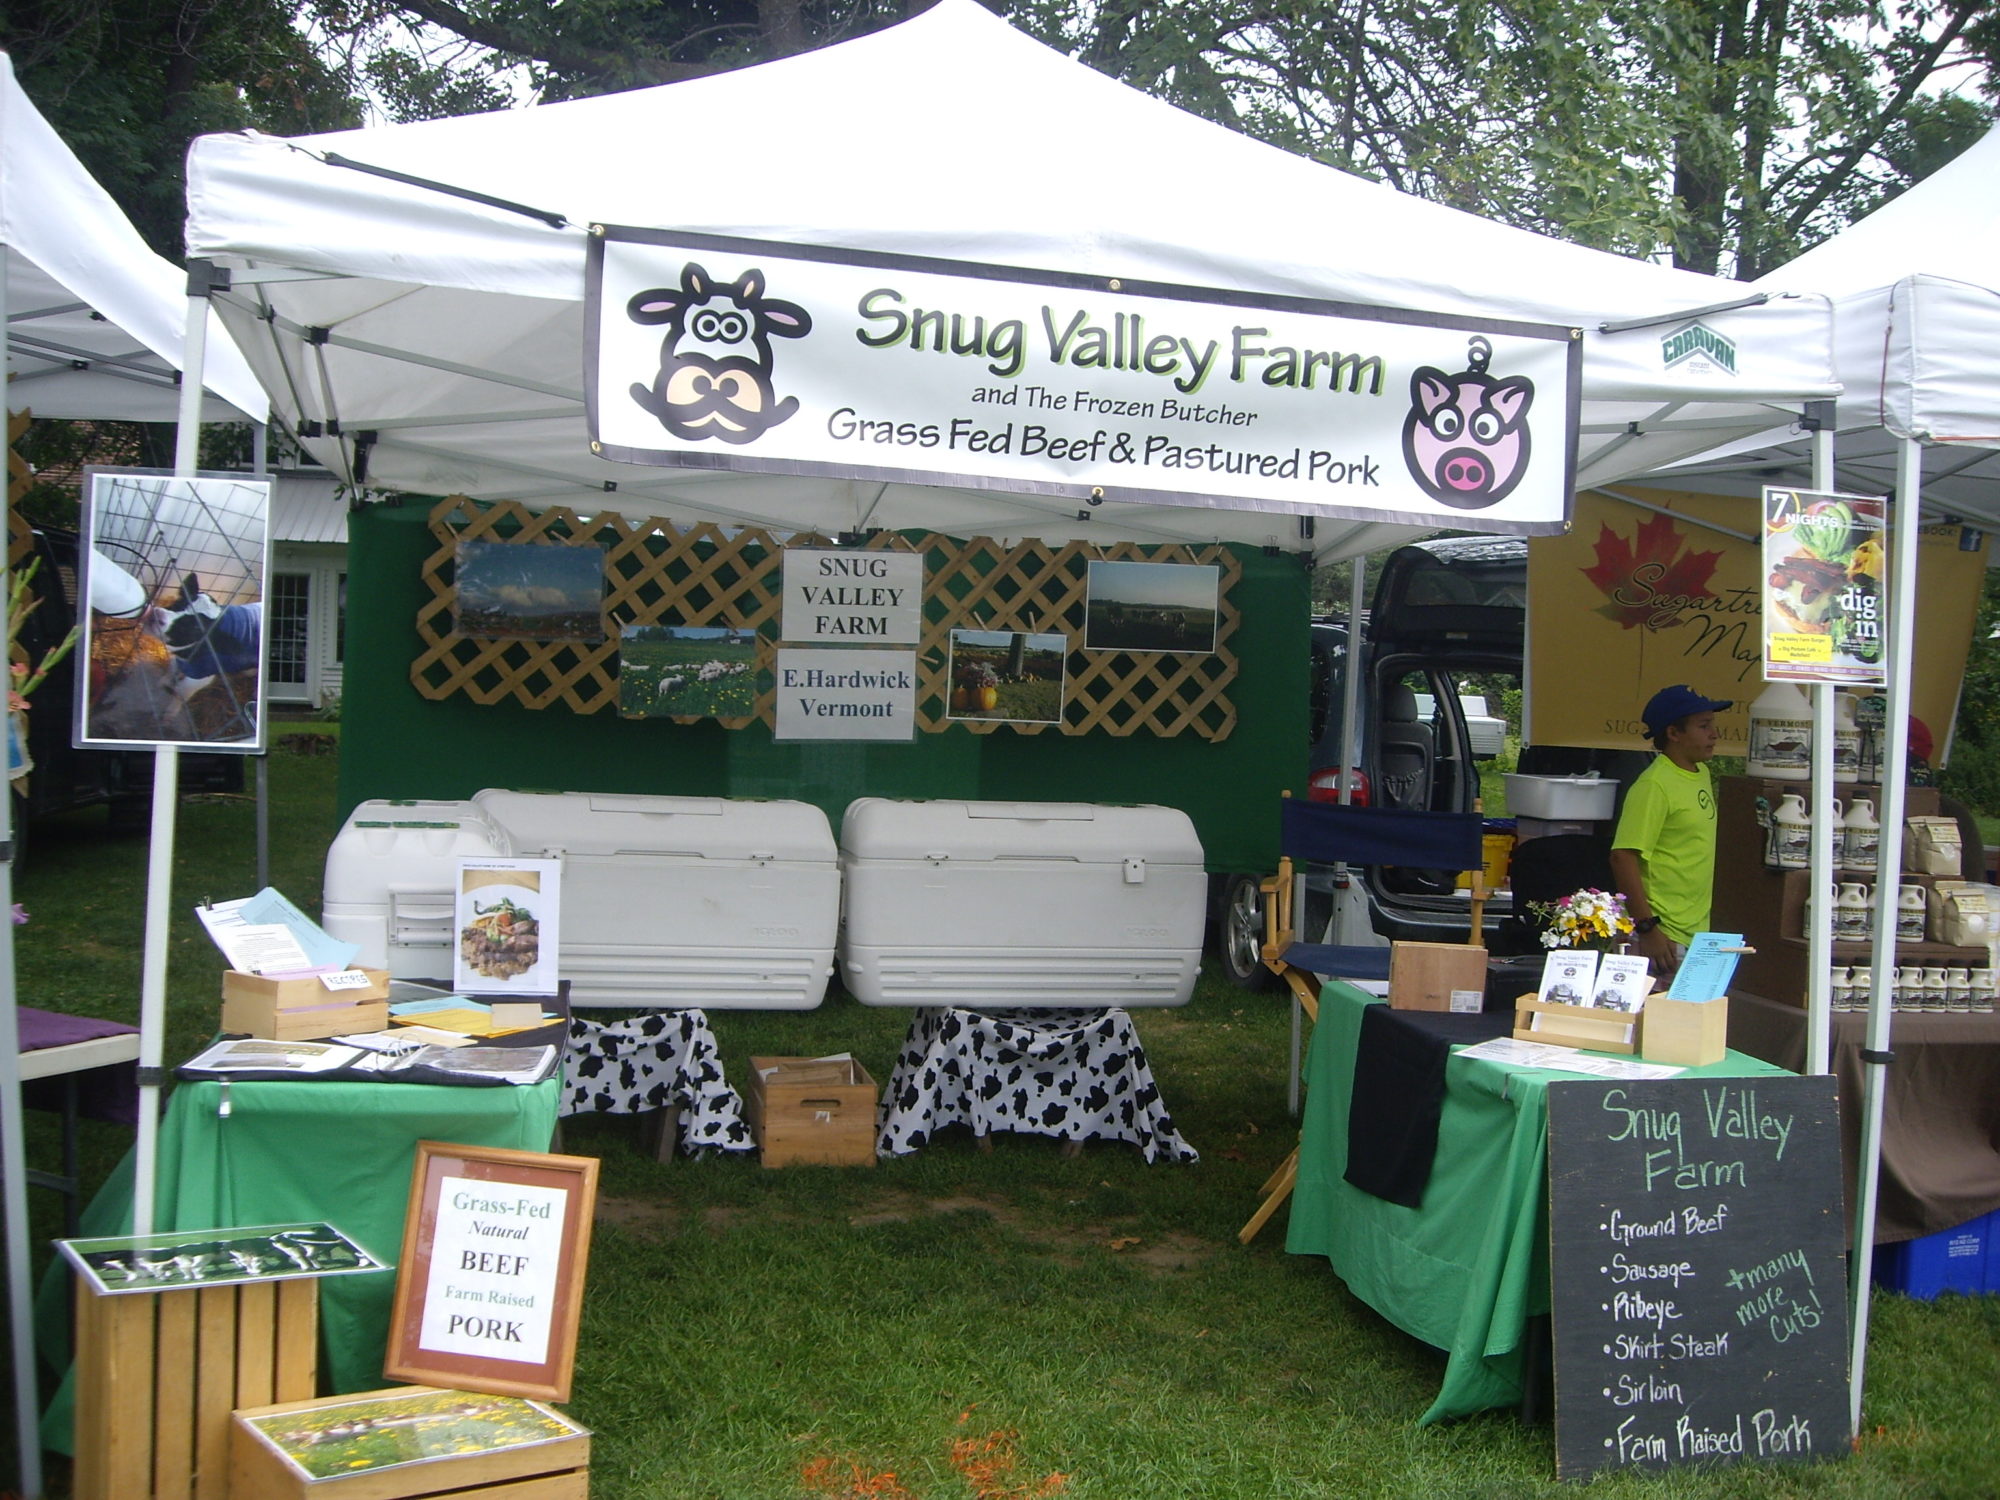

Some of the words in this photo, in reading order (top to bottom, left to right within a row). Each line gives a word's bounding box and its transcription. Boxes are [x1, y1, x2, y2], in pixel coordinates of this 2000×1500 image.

[856, 287, 1028, 378] Snug
[1041, 305, 1219, 395] Valley
[1229, 325, 1386, 397] Farm
[1662, 326, 1736, 372] CARAVAN
[971, 384, 1018, 406] and
[1025, 386, 1067, 412] The
[1074, 390, 1155, 419] Frozen
[1160, 397, 1259, 428] Butcher
[827, 407, 940, 450] Grass
[948, 417, 1012, 456] Fed
[1019, 423, 1106, 463] Beef
[1108, 431, 1137, 465] &
[1143, 434, 1300, 480] Pastured
[1307, 449, 1380, 488] Pork
[1771, 493, 1790, 523] 7
[819, 557, 888, 578] SNUG
[801, 586, 904, 607] VALLEY
[1614, 563, 1763, 634] Sugartre
[1840, 587, 1877, 620] dig
[815, 615, 888, 635] FARM
[1855, 613, 1878, 638] in
[783, 669, 911, 690] E.Hardwick
[800, 698, 894, 718] Vermont
[1603, 1089, 1684, 1166] Snug
[1703, 1086, 1794, 1161] Valley
[1645, 1149, 1747, 1192] Farm
[452, 1191, 551, 1219] Grass-Fed
[468, 1220, 530, 1240] Natural
[1610, 1208, 1676, 1247] Ground
[1681, 1203, 1729, 1236] Beef
[459, 1250, 529, 1276] BEEF
[1611, 1253, 1696, 1289] Sausage
[444, 1285, 484, 1302] Farm
[487, 1290, 535, 1308] Raised
[1613, 1290, 1684, 1330] Ribeye
[1735, 1286, 1790, 1327] more
[447, 1314, 525, 1343] PORK
[1614, 1332, 1664, 1361] Skirt
[1668, 1331, 1729, 1360] Steak
[1612, 1374, 1684, 1406] Sirloin
[1616, 1415, 1668, 1464] Farm
[1676, 1413, 1743, 1459] Raised
[1751, 1407, 1812, 1457] Pork
